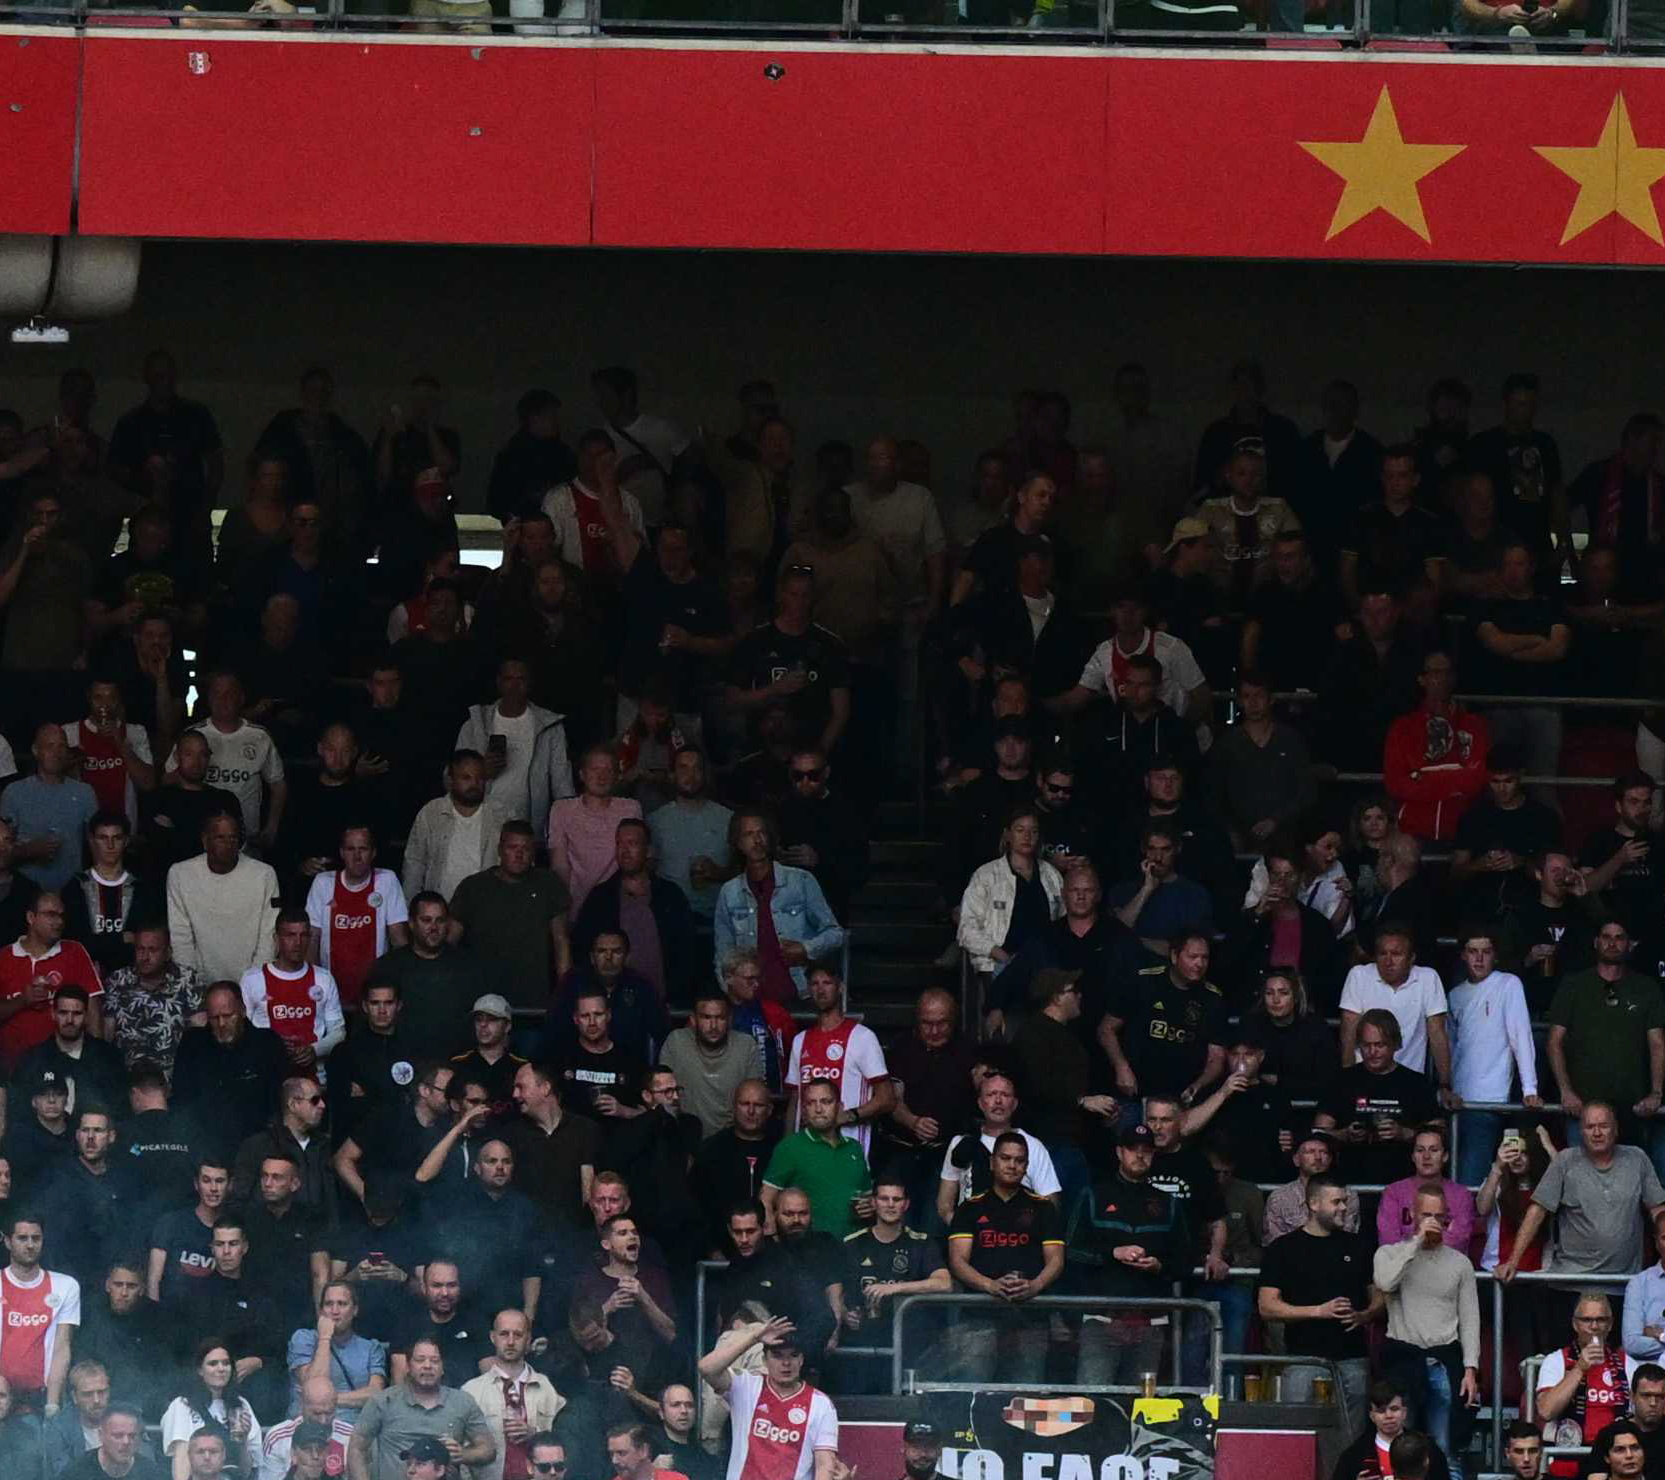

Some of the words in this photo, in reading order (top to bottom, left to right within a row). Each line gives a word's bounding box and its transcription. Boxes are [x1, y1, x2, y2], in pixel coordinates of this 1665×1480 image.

[94, 916, 124, 931] Zigg
[334, 914, 372, 929] Ziggo
[273, 1004, 315, 1019] Ziggo
[980, 1229, 1029, 1248] Ziggo
[8, 1311, 48, 1327] Ziggo
[753, 1421, 799, 1443] Ziggo
